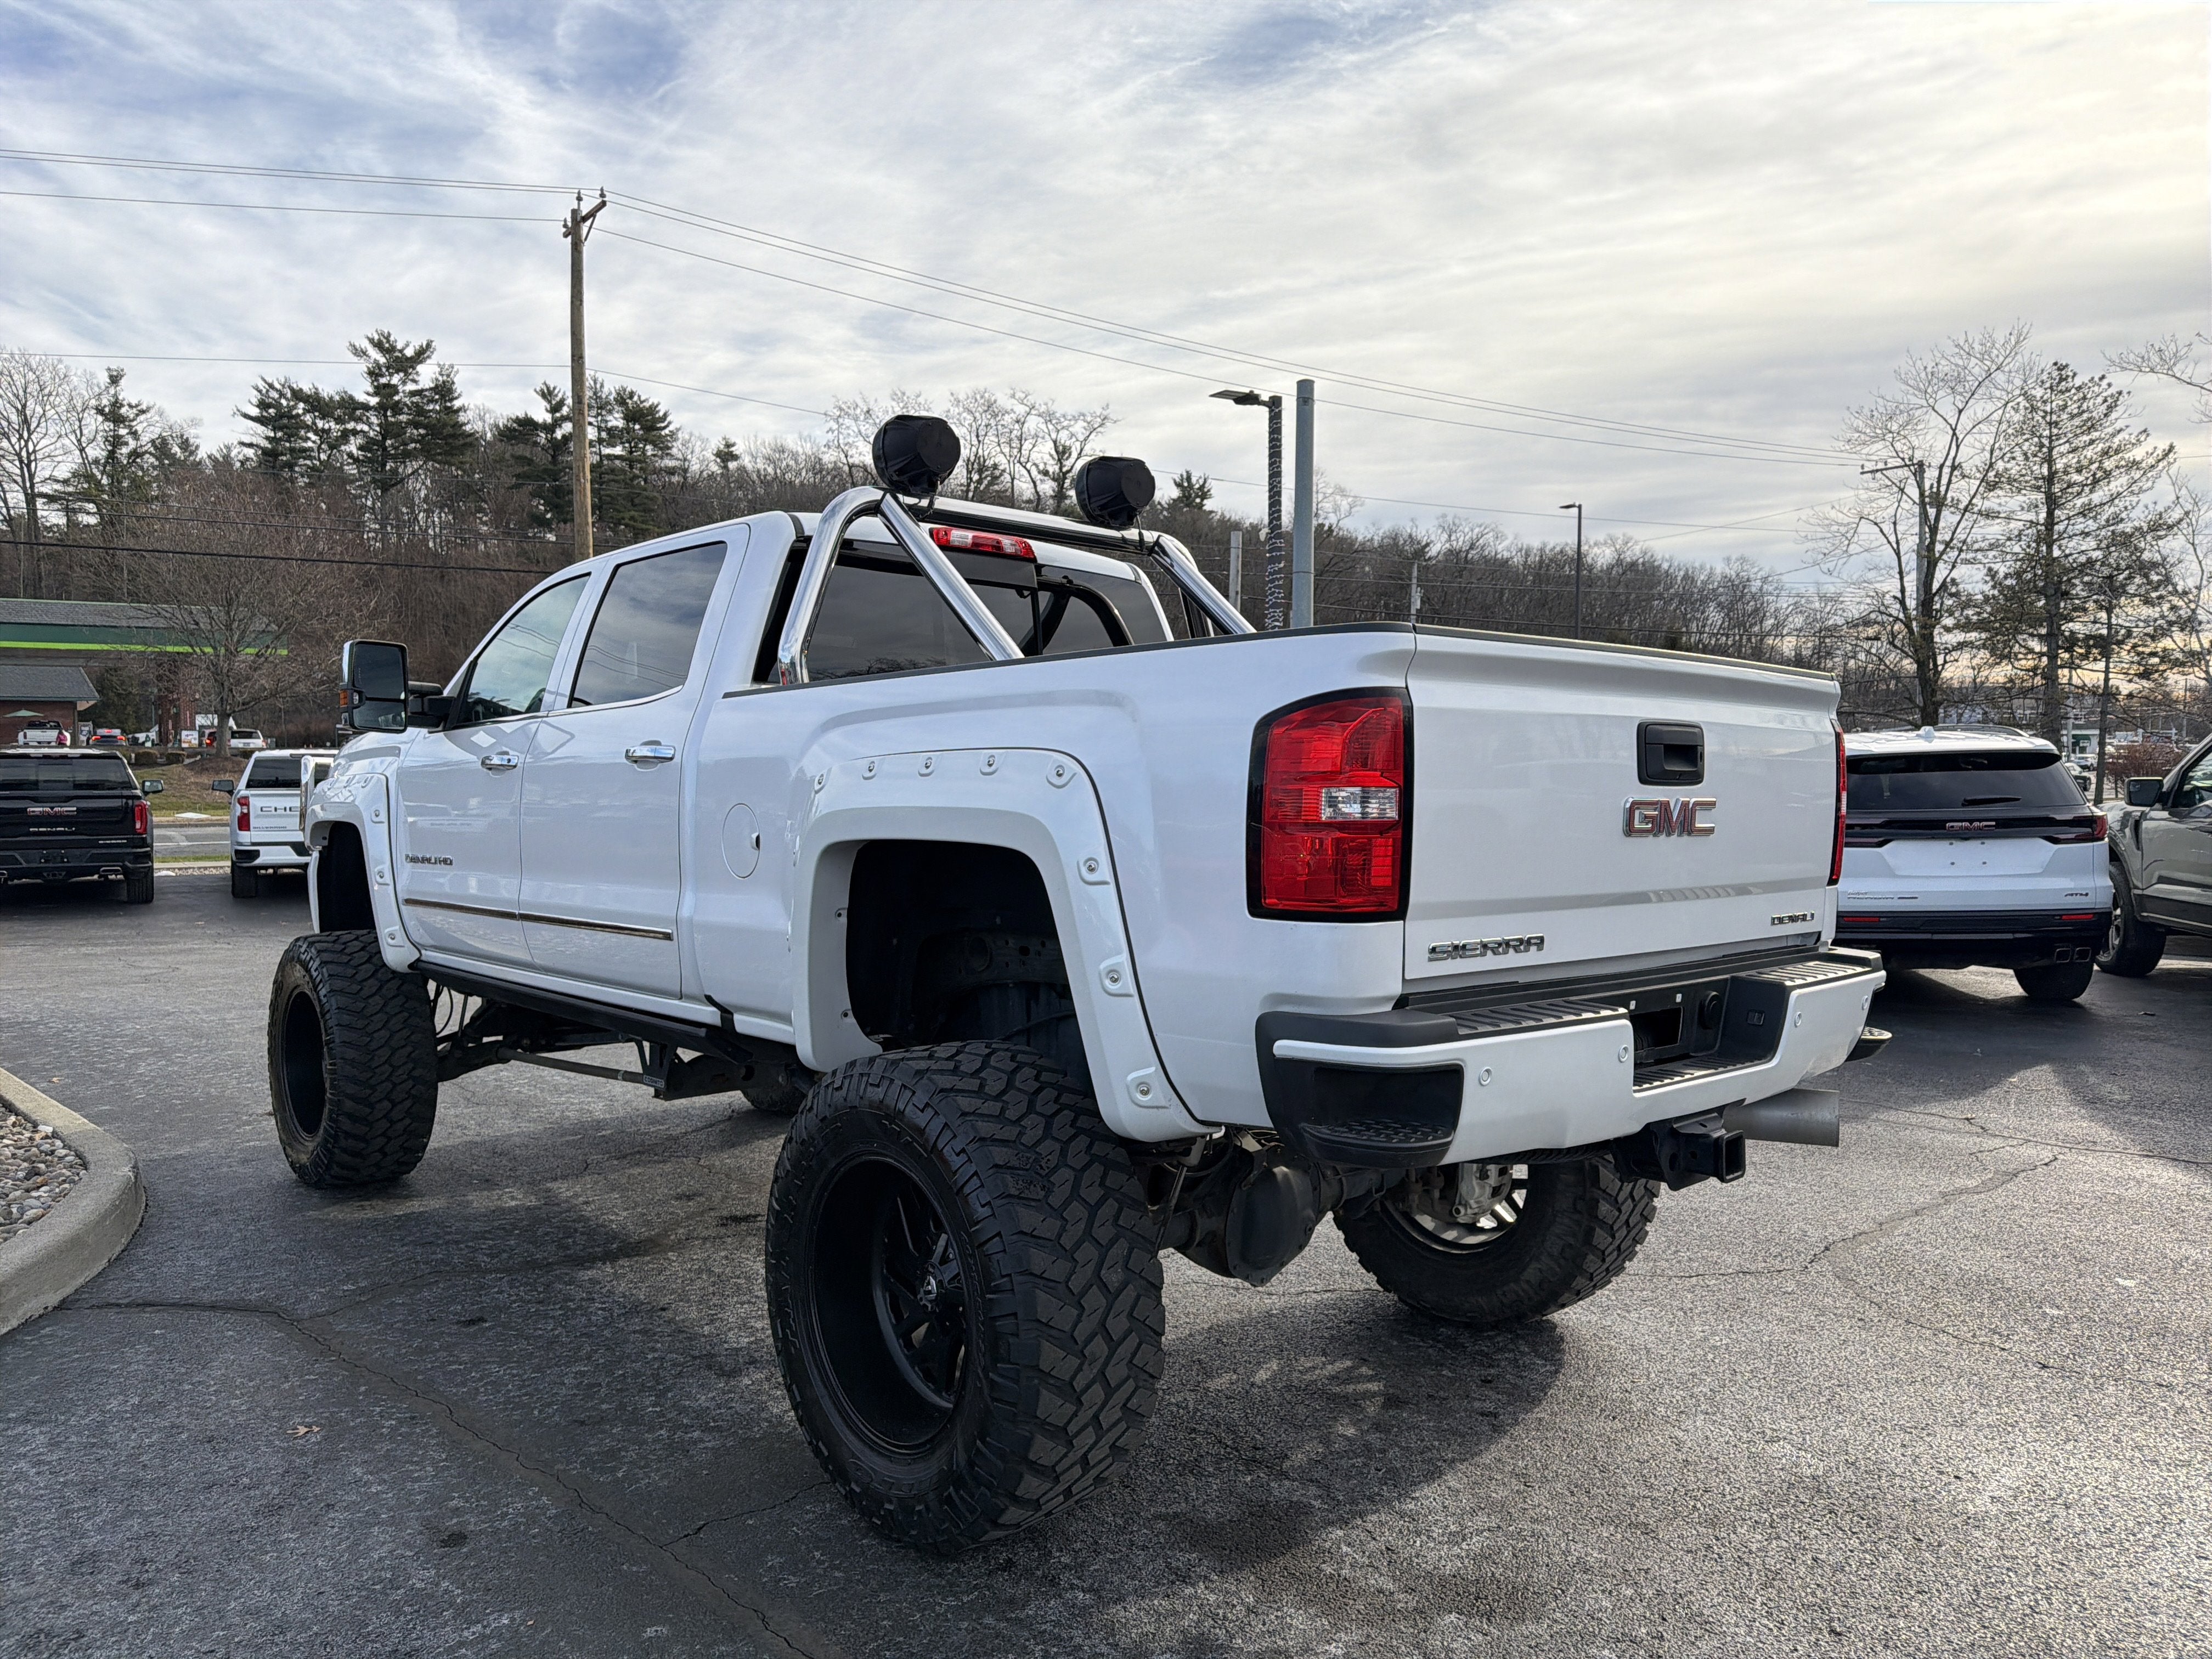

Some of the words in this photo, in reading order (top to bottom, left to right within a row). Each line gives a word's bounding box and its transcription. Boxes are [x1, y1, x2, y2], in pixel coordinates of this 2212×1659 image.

[27, 807, 77, 815] GMC
[1623, 797, 1717, 837] GMC
[1946, 822, 1996, 831] GMC
[1770, 910, 1815, 926] DENALI
[1427, 934, 1545, 962] SIERRA
